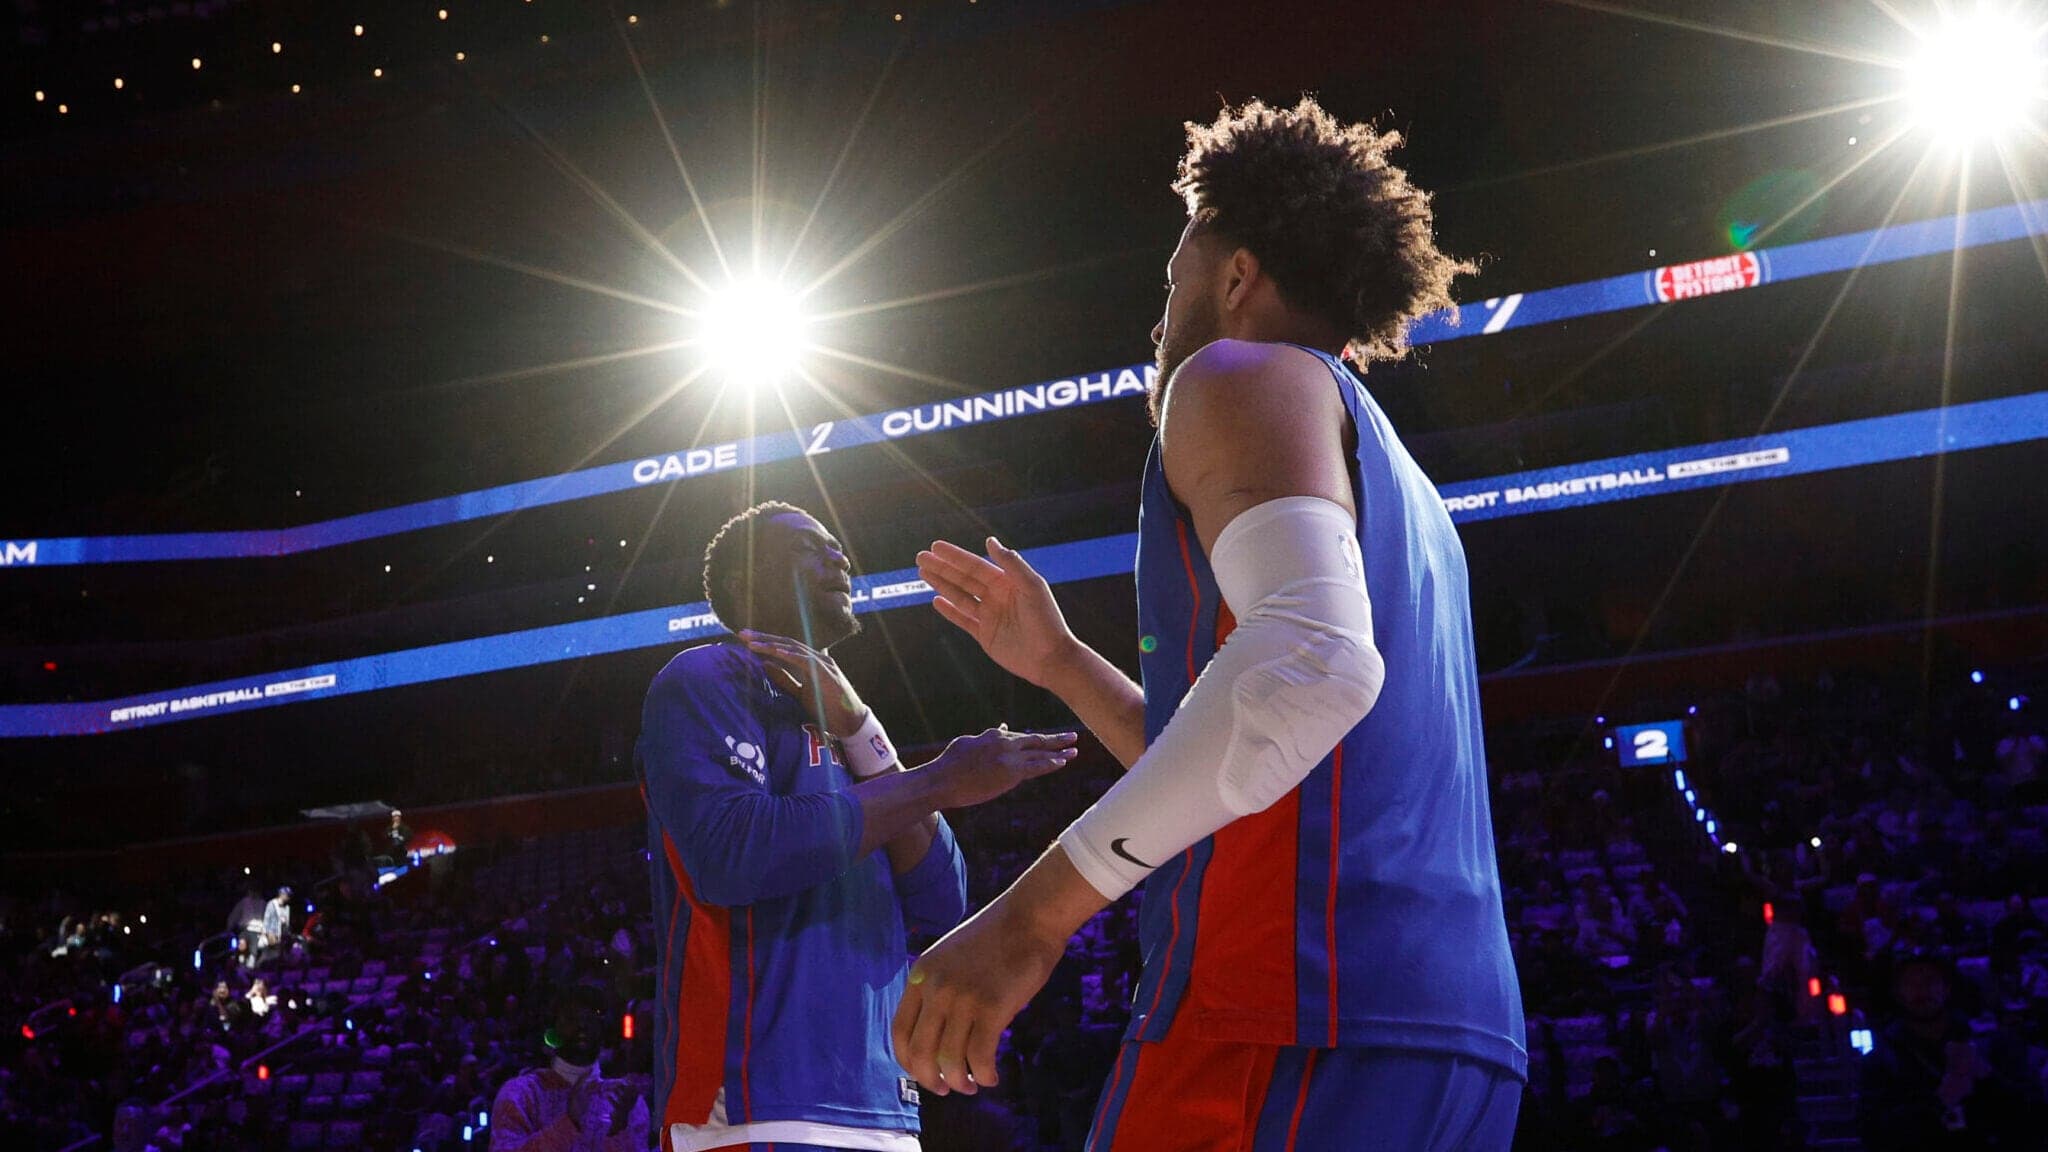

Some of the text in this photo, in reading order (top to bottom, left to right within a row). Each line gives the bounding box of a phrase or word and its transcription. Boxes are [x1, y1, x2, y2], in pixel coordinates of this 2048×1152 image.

[632, 443, 738, 484] CADE
[805, 422, 834, 456] 2
[1505, 467, 1666, 504] BASKETBALL
[668, 612, 721, 632] DETR
[110, 686, 263, 723] DETROIT BASKETBALL
[1633, 729, 1669, 760] 2
